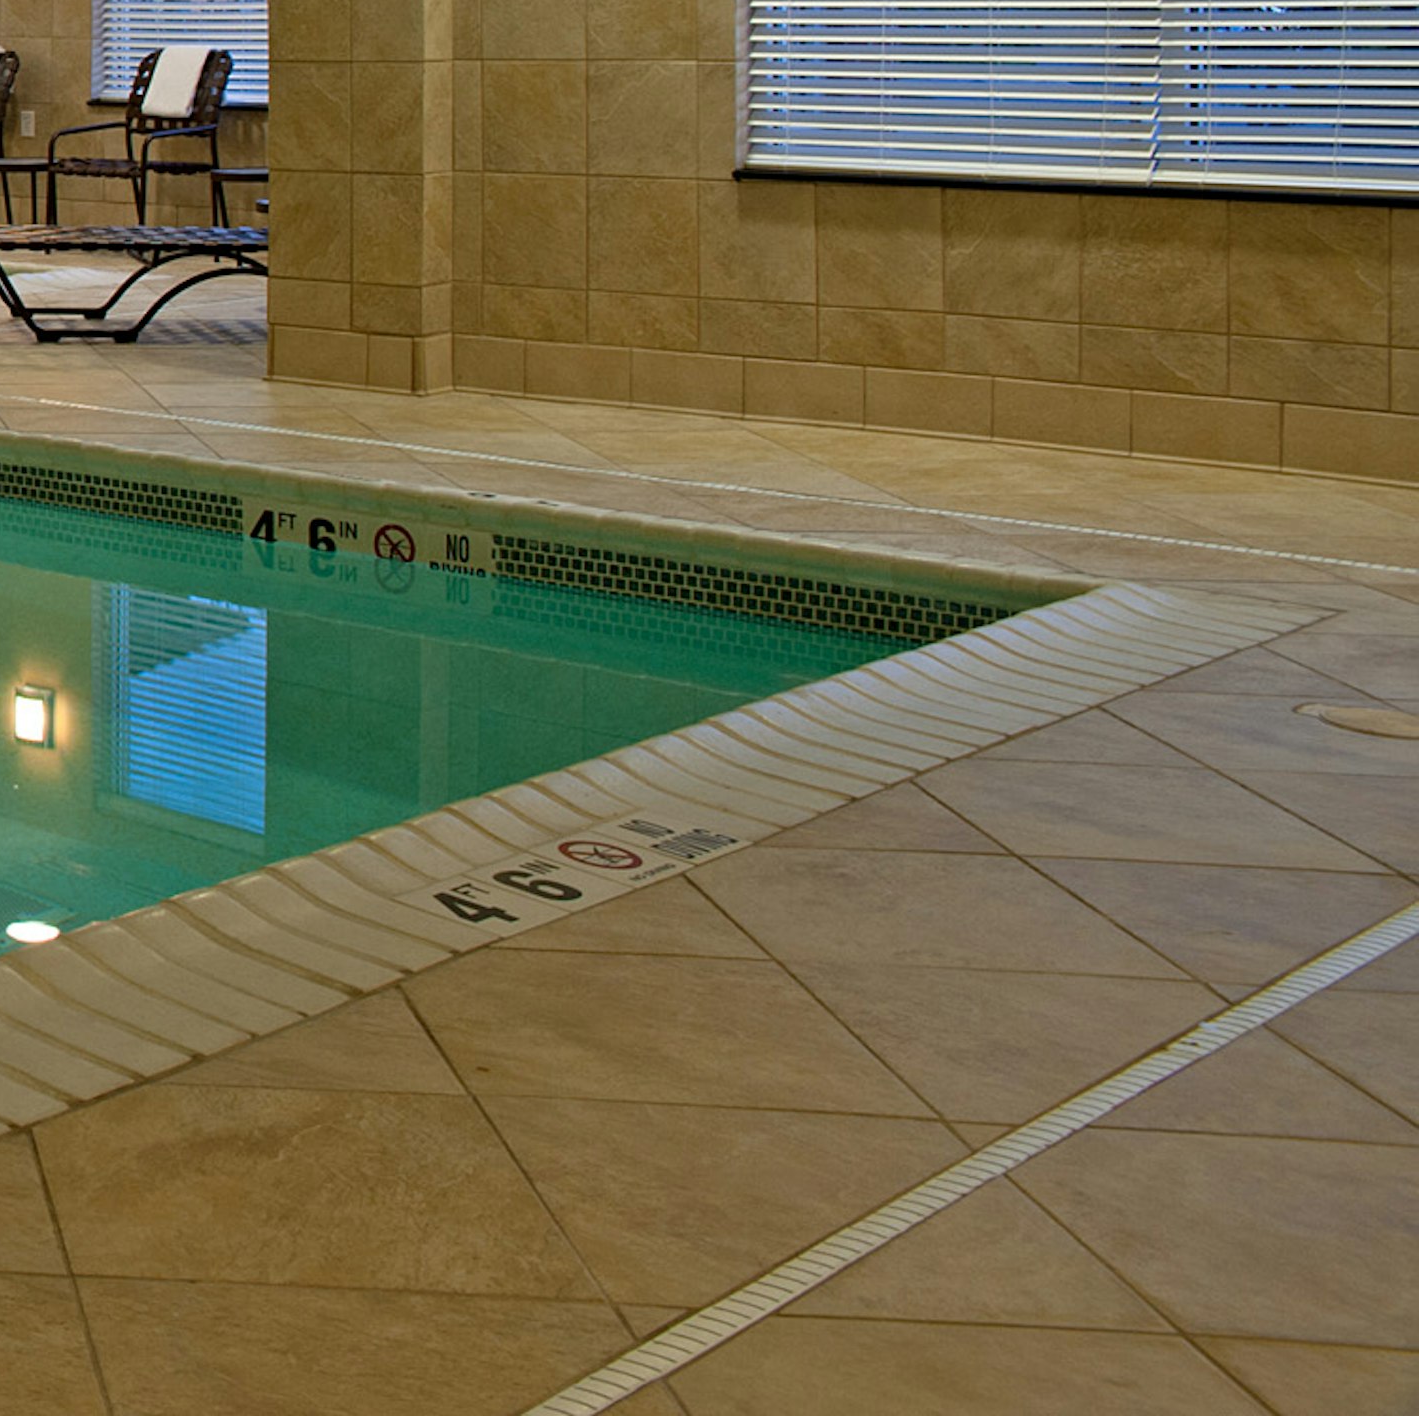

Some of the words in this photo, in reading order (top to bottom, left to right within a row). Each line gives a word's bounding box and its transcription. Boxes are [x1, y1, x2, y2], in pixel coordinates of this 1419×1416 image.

[250, 510, 278, 543] 4
[278, 513, 297, 530] FT
[308, 517, 337, 553] 6
[339, 521, 358, 540] IN
[446, 533, 470, 563] NO
[518, 859, 561, 876] IN
[450, 883, 491, 900] FT
[492, 869, 583, 902] 6
[432, 892, 520, 924] 4
